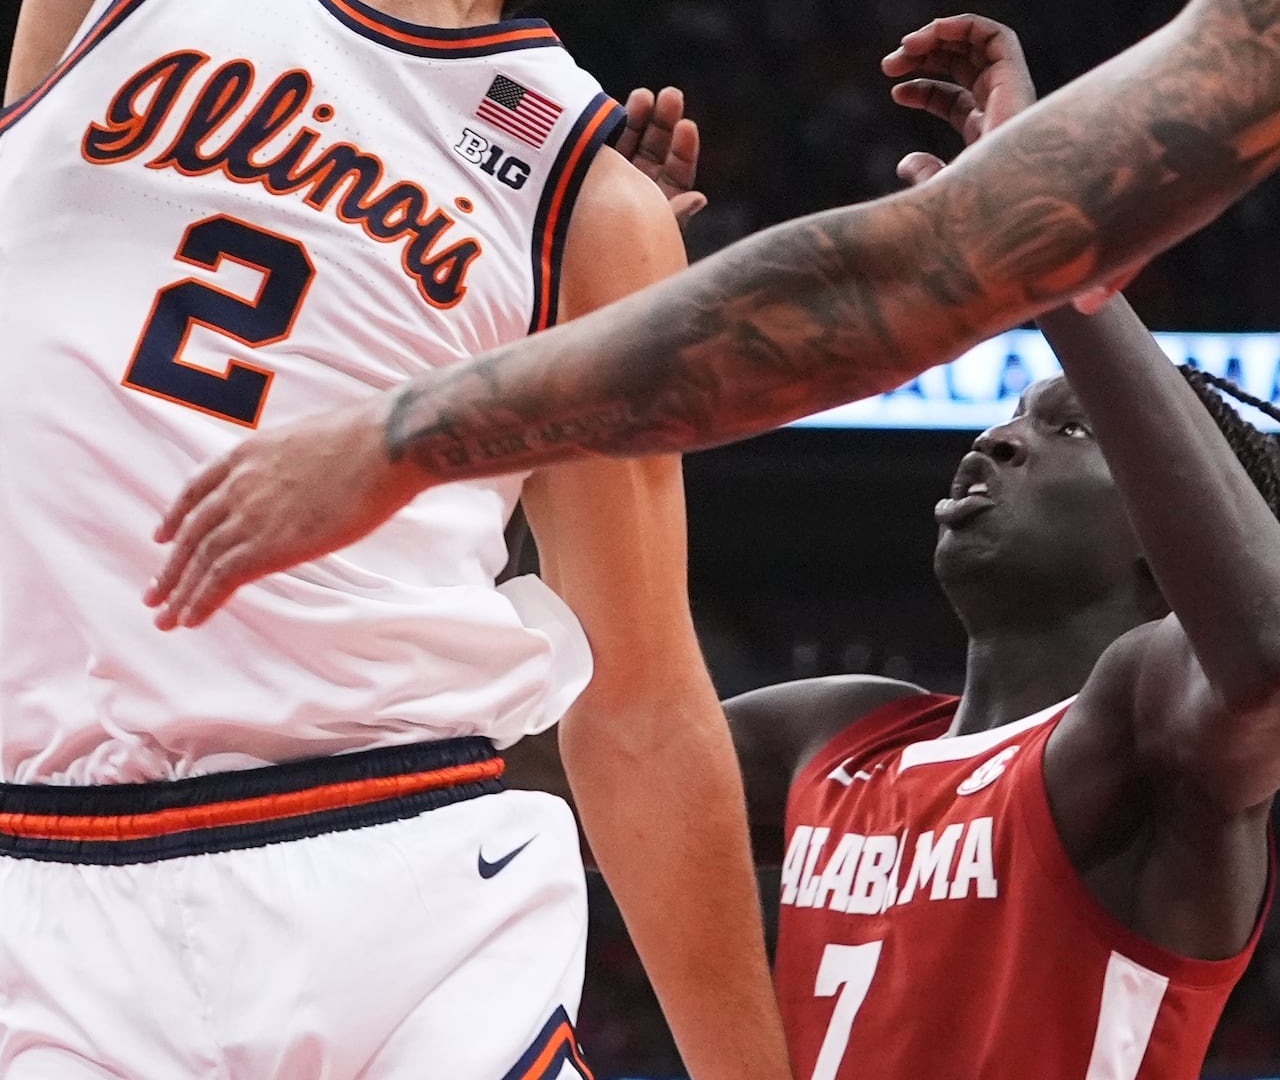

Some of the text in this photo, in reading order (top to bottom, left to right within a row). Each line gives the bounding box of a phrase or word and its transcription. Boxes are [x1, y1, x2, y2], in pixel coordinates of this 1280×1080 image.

[81, 49, 482, 309] Illinois
[121, 214, 317, 429] 2
[810, 940, 883, 1080] 7
